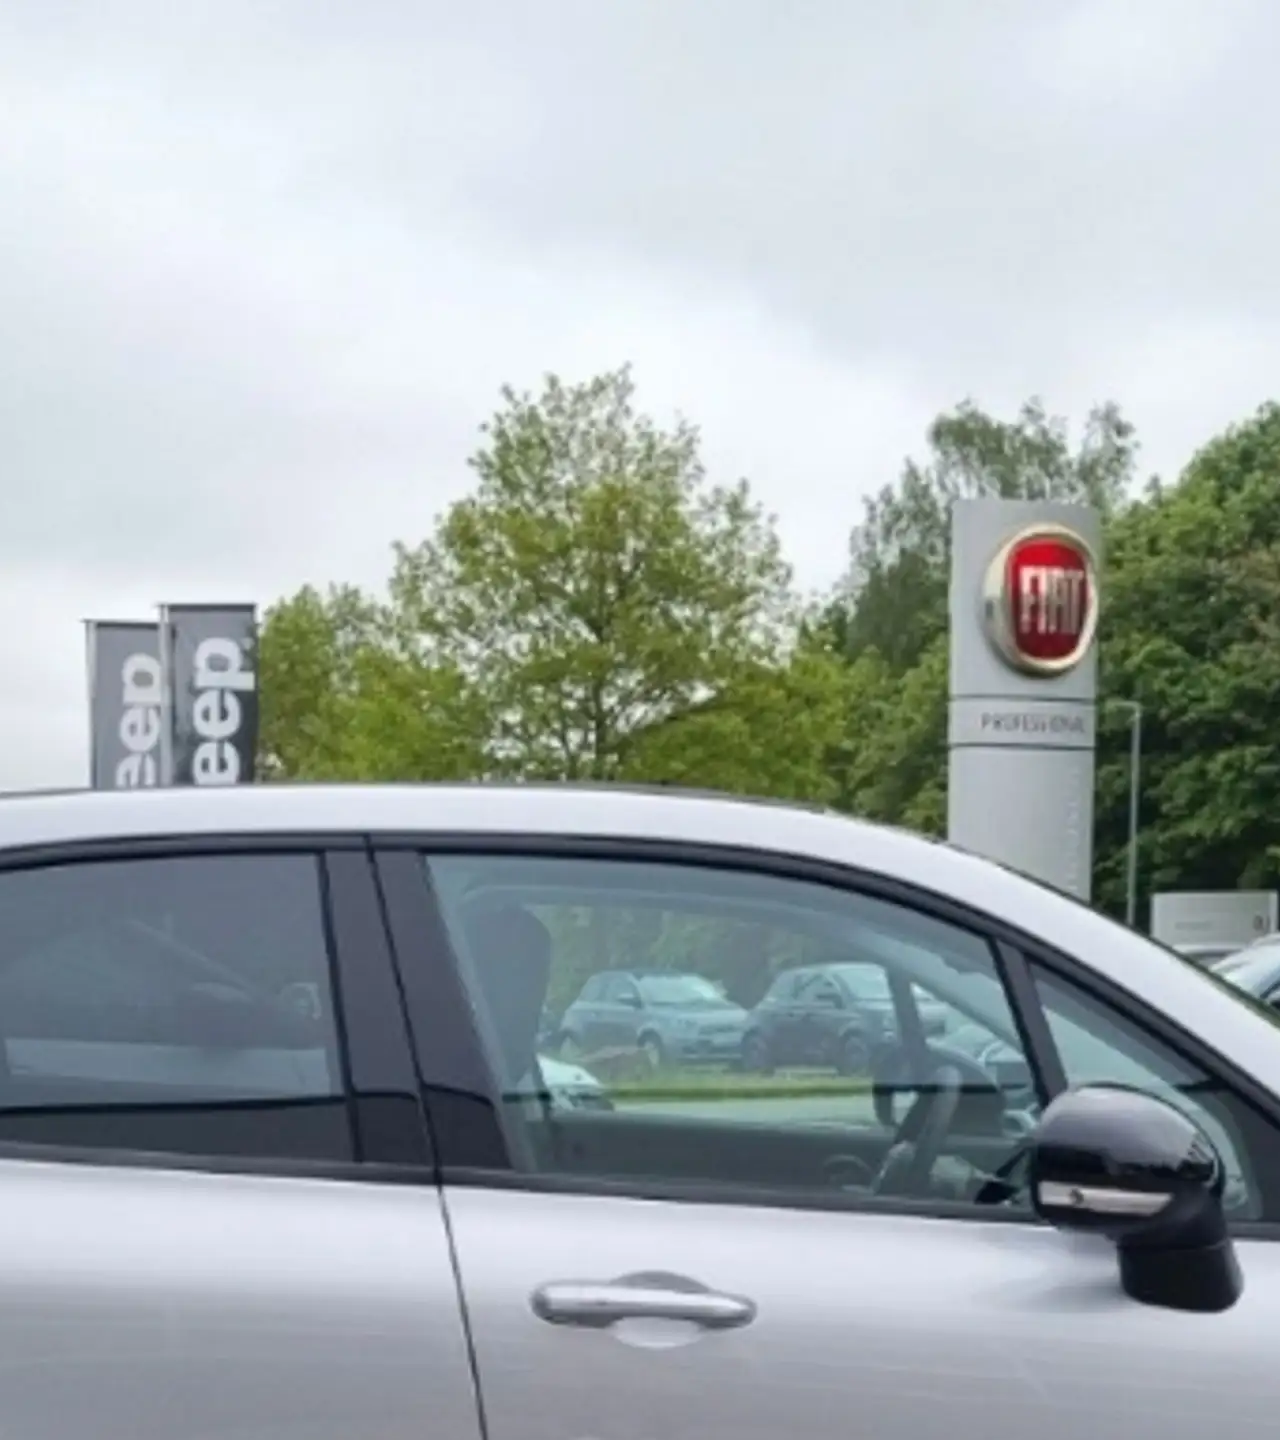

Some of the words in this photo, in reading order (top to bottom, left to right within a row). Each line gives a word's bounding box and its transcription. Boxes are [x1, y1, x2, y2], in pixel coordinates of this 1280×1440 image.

[1019, 566, 1085, 635] FIAT
[116, 653, 162, 788] eep
[193, 637, 256, 786] eep
